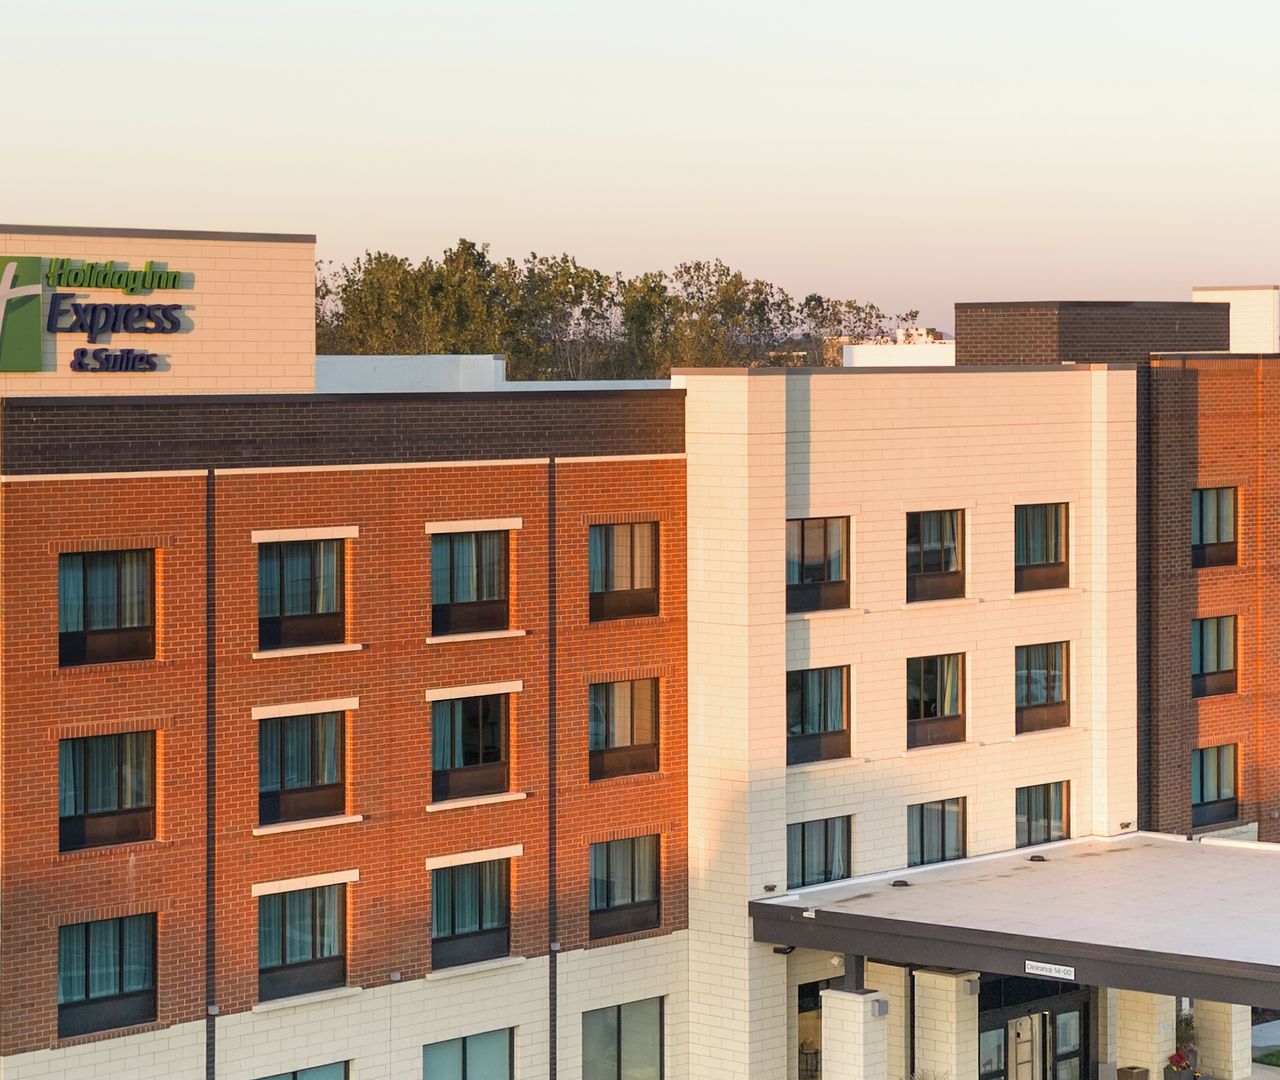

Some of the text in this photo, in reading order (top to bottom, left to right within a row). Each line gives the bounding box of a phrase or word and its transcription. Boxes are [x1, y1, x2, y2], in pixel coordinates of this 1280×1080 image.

[47, 293, 182, 344] Express
[70, 348, 158, 372] & Suites
[1026, 962, 1053, 973] Clearance
